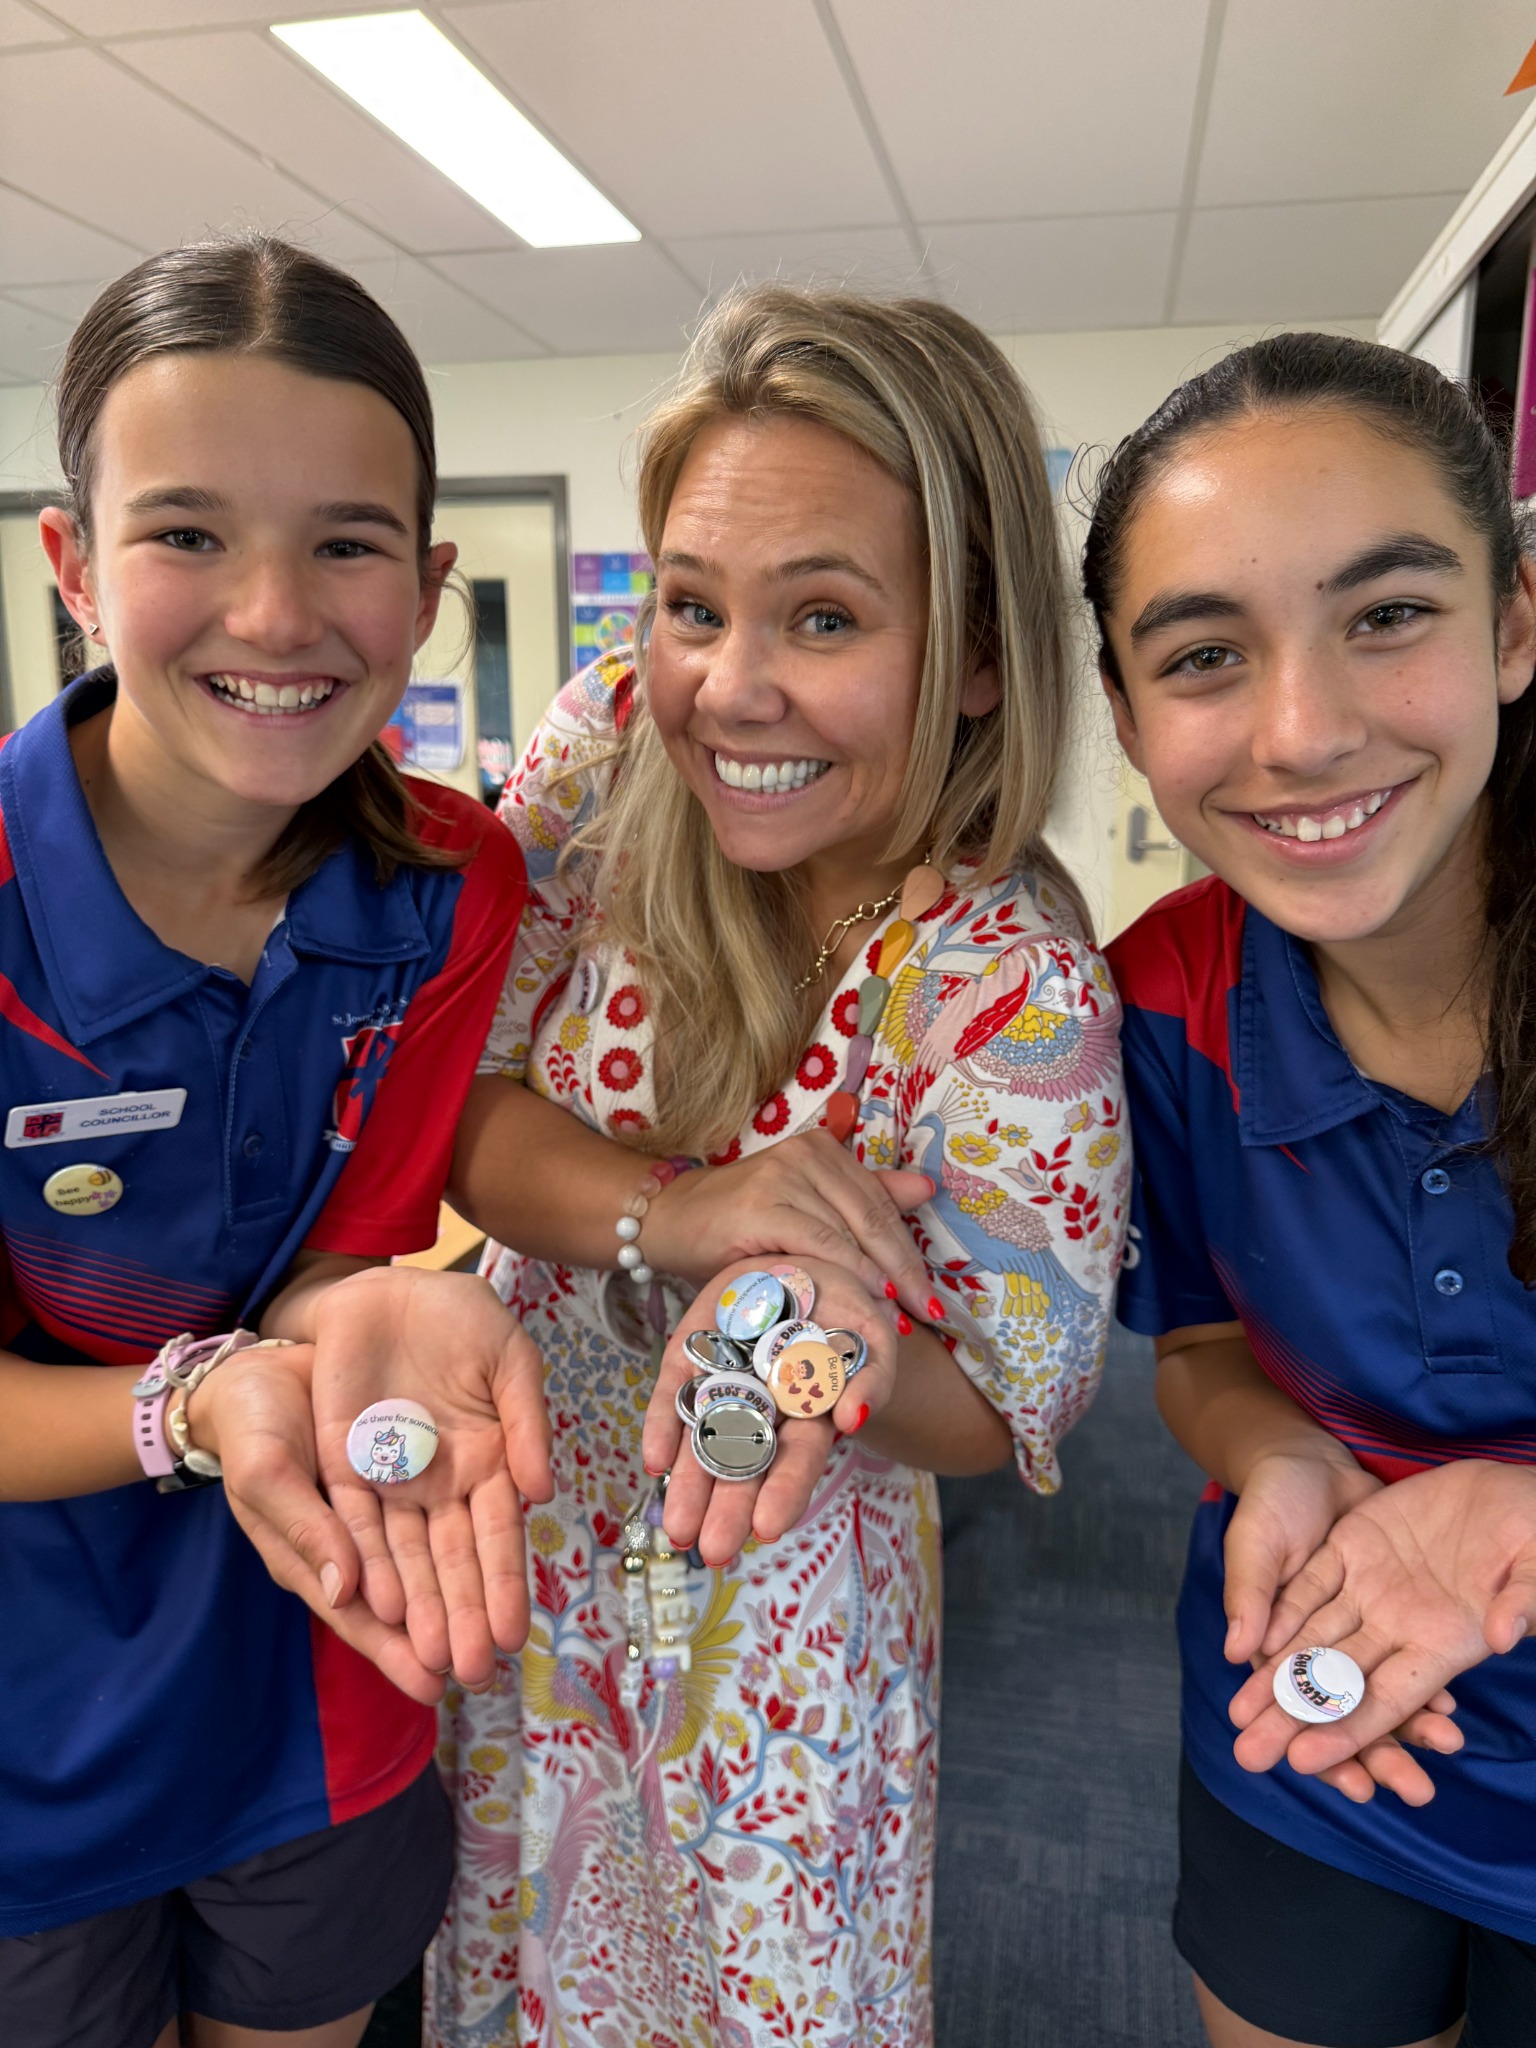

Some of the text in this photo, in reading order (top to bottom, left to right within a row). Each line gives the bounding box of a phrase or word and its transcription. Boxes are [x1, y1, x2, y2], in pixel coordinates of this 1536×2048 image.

[99, 1103, 157, 1117] SCHOOL
[80, 1111, 172, 1128] COUNCILLOR
[54, 1195, 92, 1206] happy
[782, 1321, 804, 1341] DAY
[827, 1356, 840, 1392] Be you
[709, 1385, 770, 1413] FLO'S DAY
[370, 1414, 394, 1423] there
[395, 1413, 410, 1423] for
[1293, 1653, 1331, 1706] FLO'S DAY
